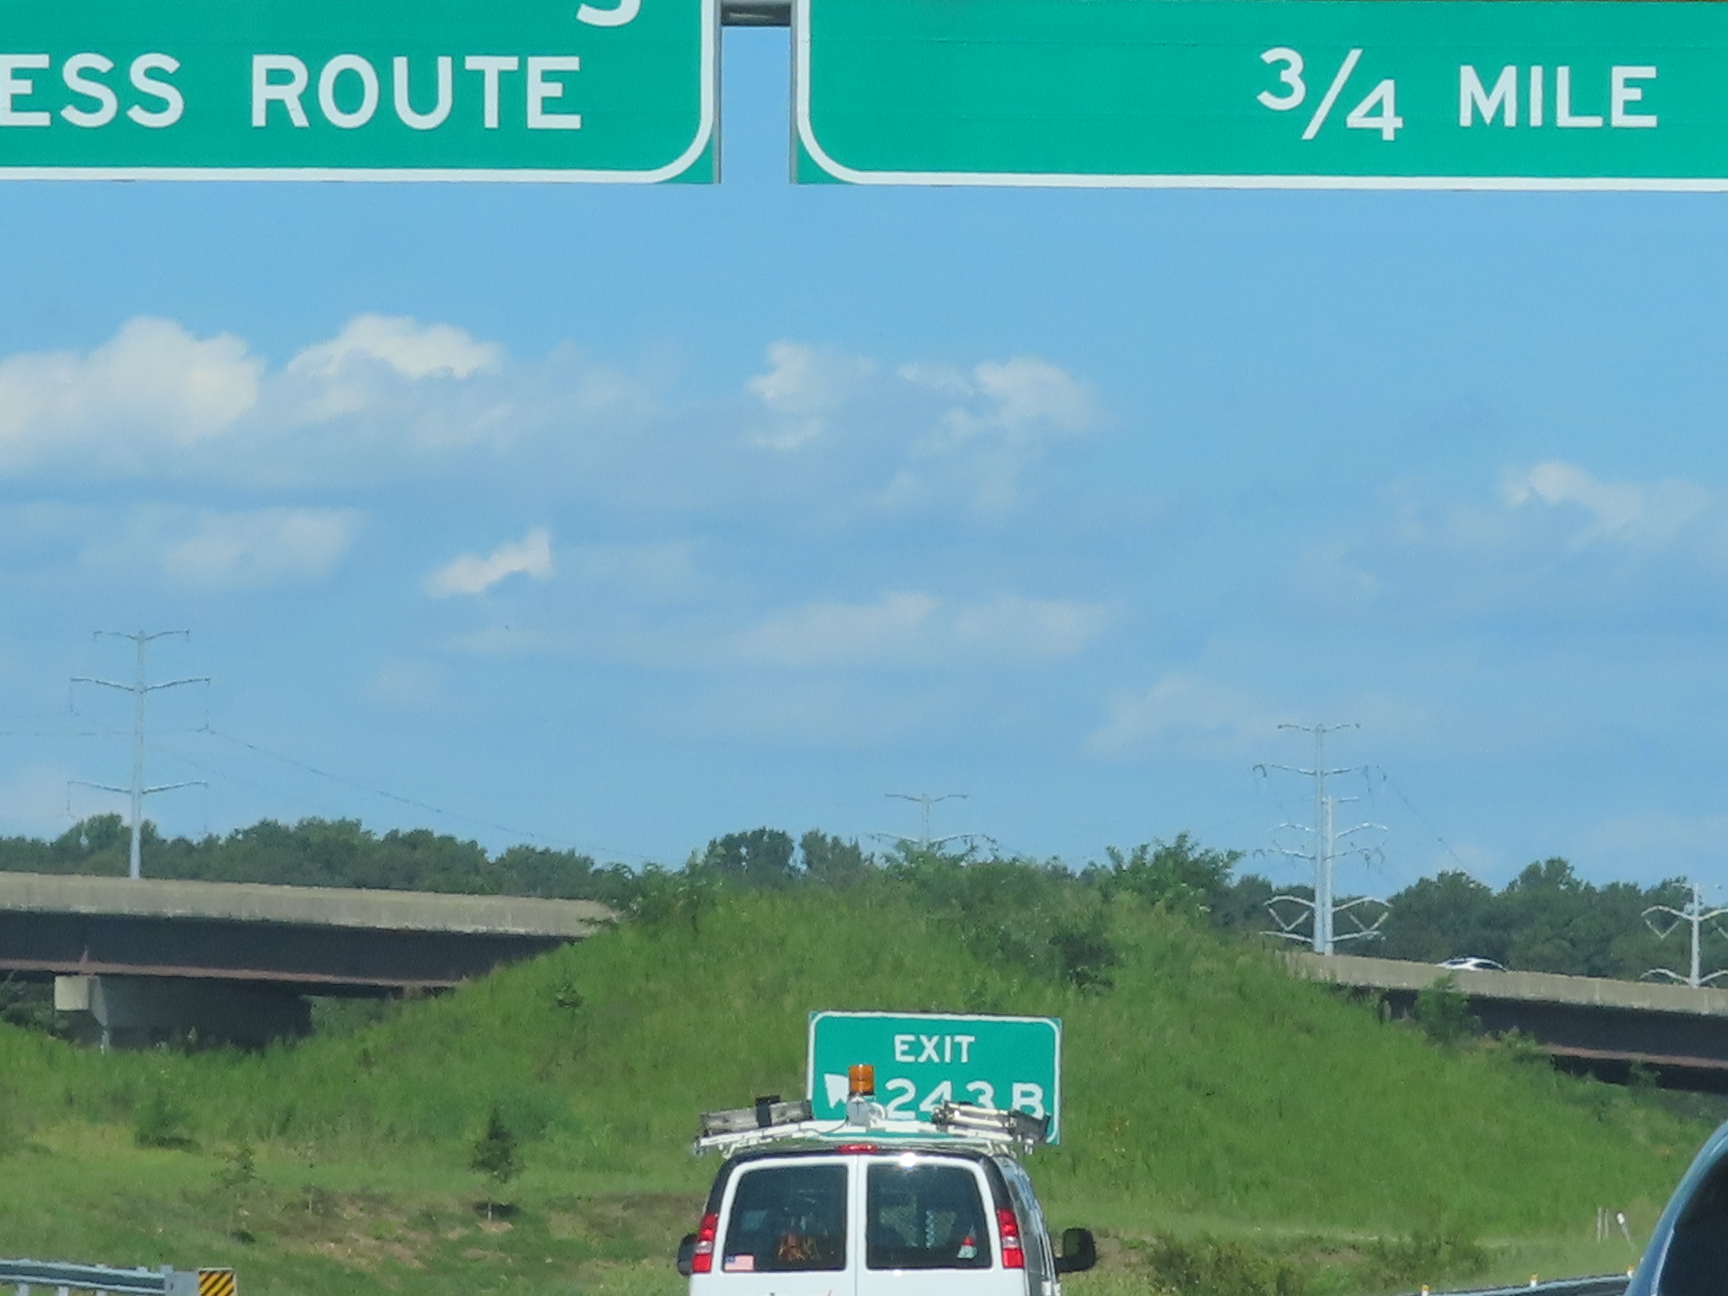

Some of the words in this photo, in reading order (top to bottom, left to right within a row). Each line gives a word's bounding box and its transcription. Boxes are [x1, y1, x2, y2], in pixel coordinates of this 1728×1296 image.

[250, 54, 583, 132] ROUTE
[1256, 46, 1404, 143] 3/4
[1458, 65, 1658, 130] MILE
[894, 1034, 976, 1064] EXIT
